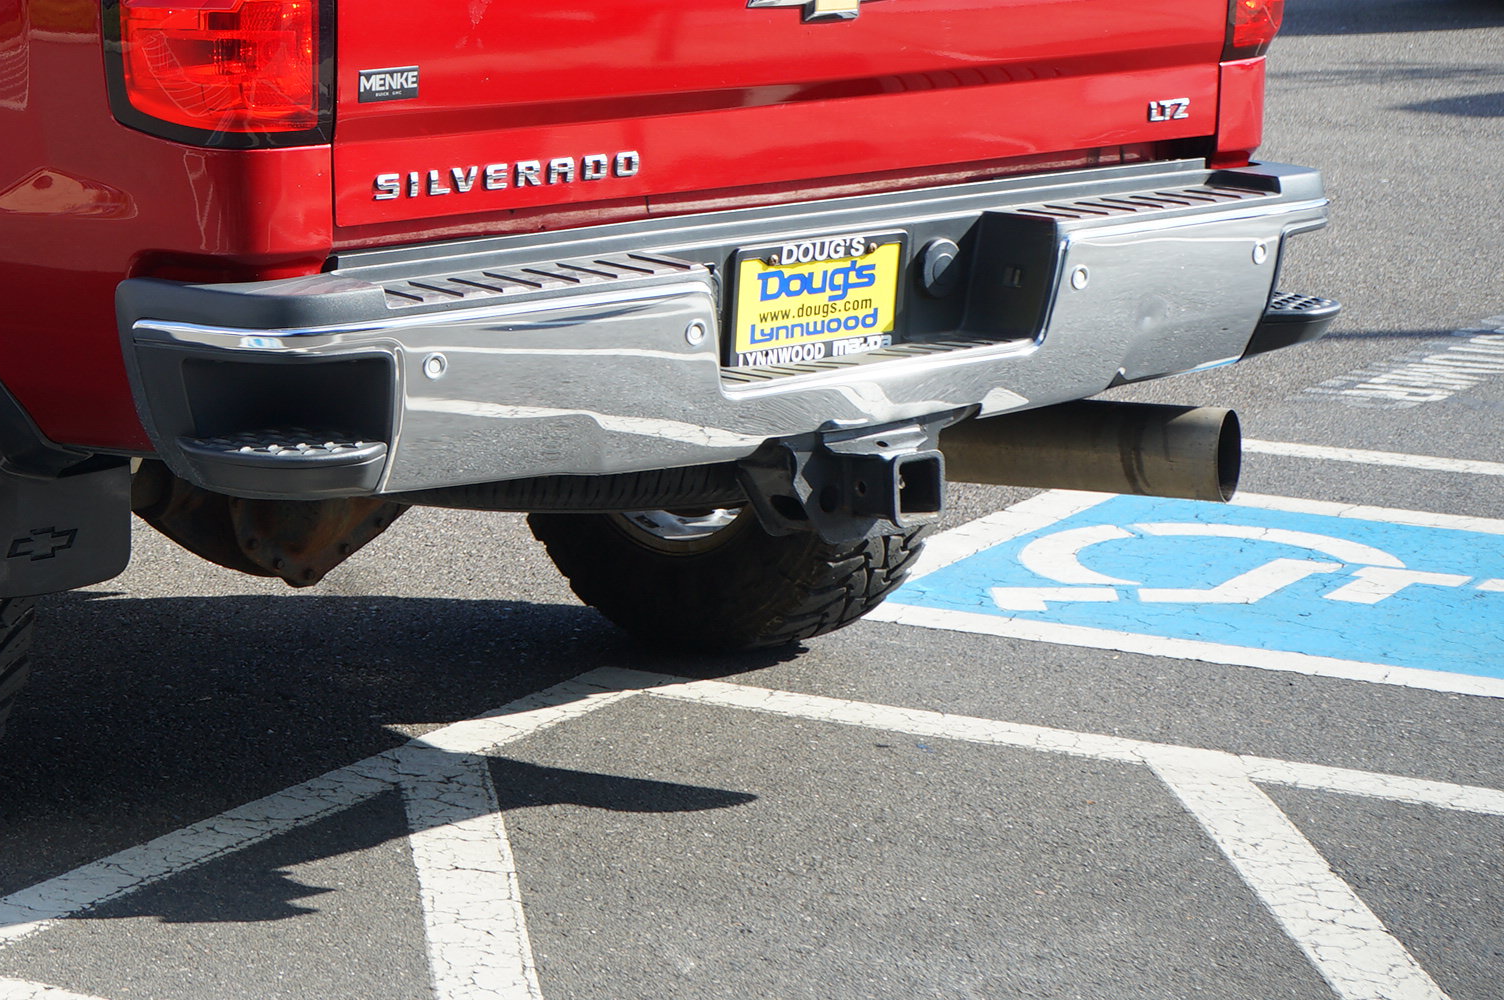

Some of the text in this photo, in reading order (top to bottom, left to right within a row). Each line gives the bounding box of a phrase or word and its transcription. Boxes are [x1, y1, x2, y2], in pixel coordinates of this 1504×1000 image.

[360, 71, 418, 92] MENKE
[1147, 97, 1190, 122] LTZ
[373, 150, 641, 201] SILVERADO
[781, 236, 865, 266] DOUG'S
[757, 260, 876, 302] Doug's
[759, 298, 873, 324] www.dougs.com
[750, 307, 879, 345] Lynnwood
[738, 342, 825, 368] LYNNWOOD
